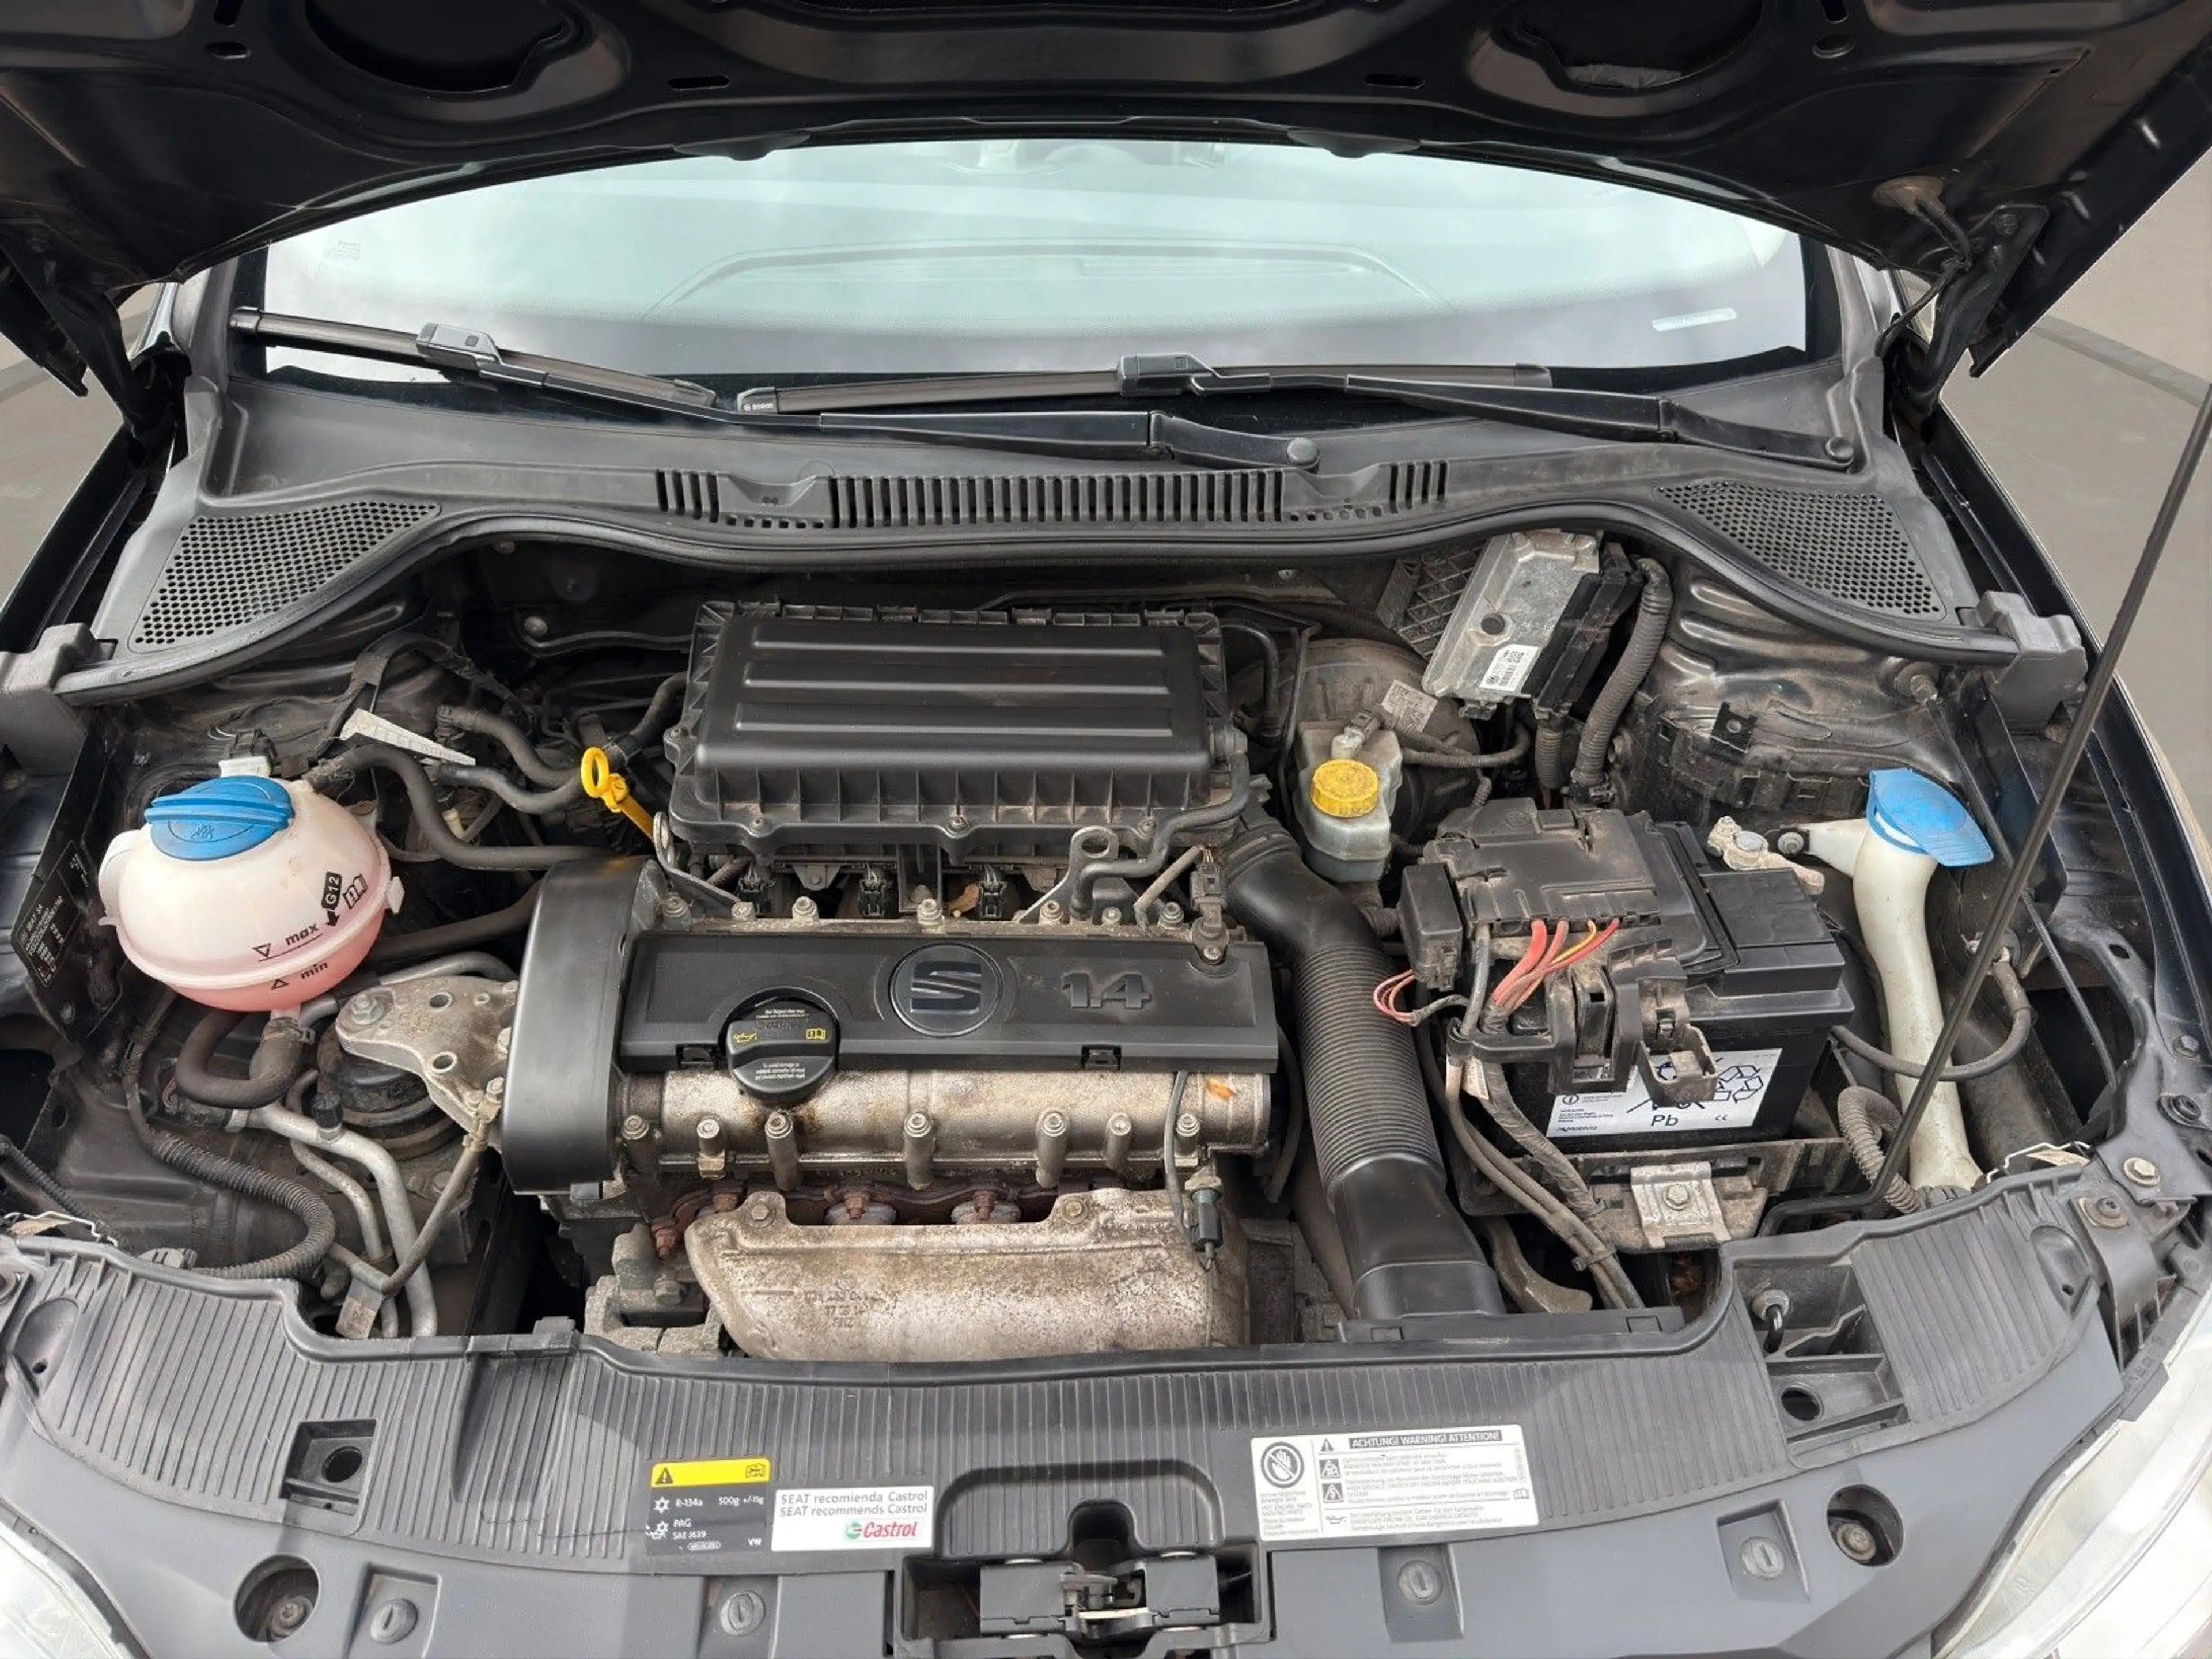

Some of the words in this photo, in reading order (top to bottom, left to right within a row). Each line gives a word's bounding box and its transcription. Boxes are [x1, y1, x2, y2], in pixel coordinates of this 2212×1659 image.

[325, 876, 339, 904] G12
[285, 923, 319, 945] max
[301, 963, 328, 979] min
[1061, 972, 1151, 1009] 1.4
[1651, 1114, 1679, 1126] Pb
[1352, 1437, 1398, 1447] ACHTUNG!
[1401, 1434, 1446, 1445] WARNING!
[1449, 1431, 1500, 1442] ATTENTION!
[781, 1494, 810, 1504] SEAT
[814, 1492, 883, 1503] recomienda
[888, 1490, 927, 1502] Castrol
[780, 1506, 808, 1517] SEAT
[811, 1504, 884, 1516] recommends
[888, 1503, 927, 1514] Castrol
[673, 1518, 692, 1527] PAG
[863, 1521, 918, 1538] Castrol
[672, 1531, 687, 1540] SAE
[688, 1530, 706, 1539] J639
[748, 1537, 762, 1546] VW
